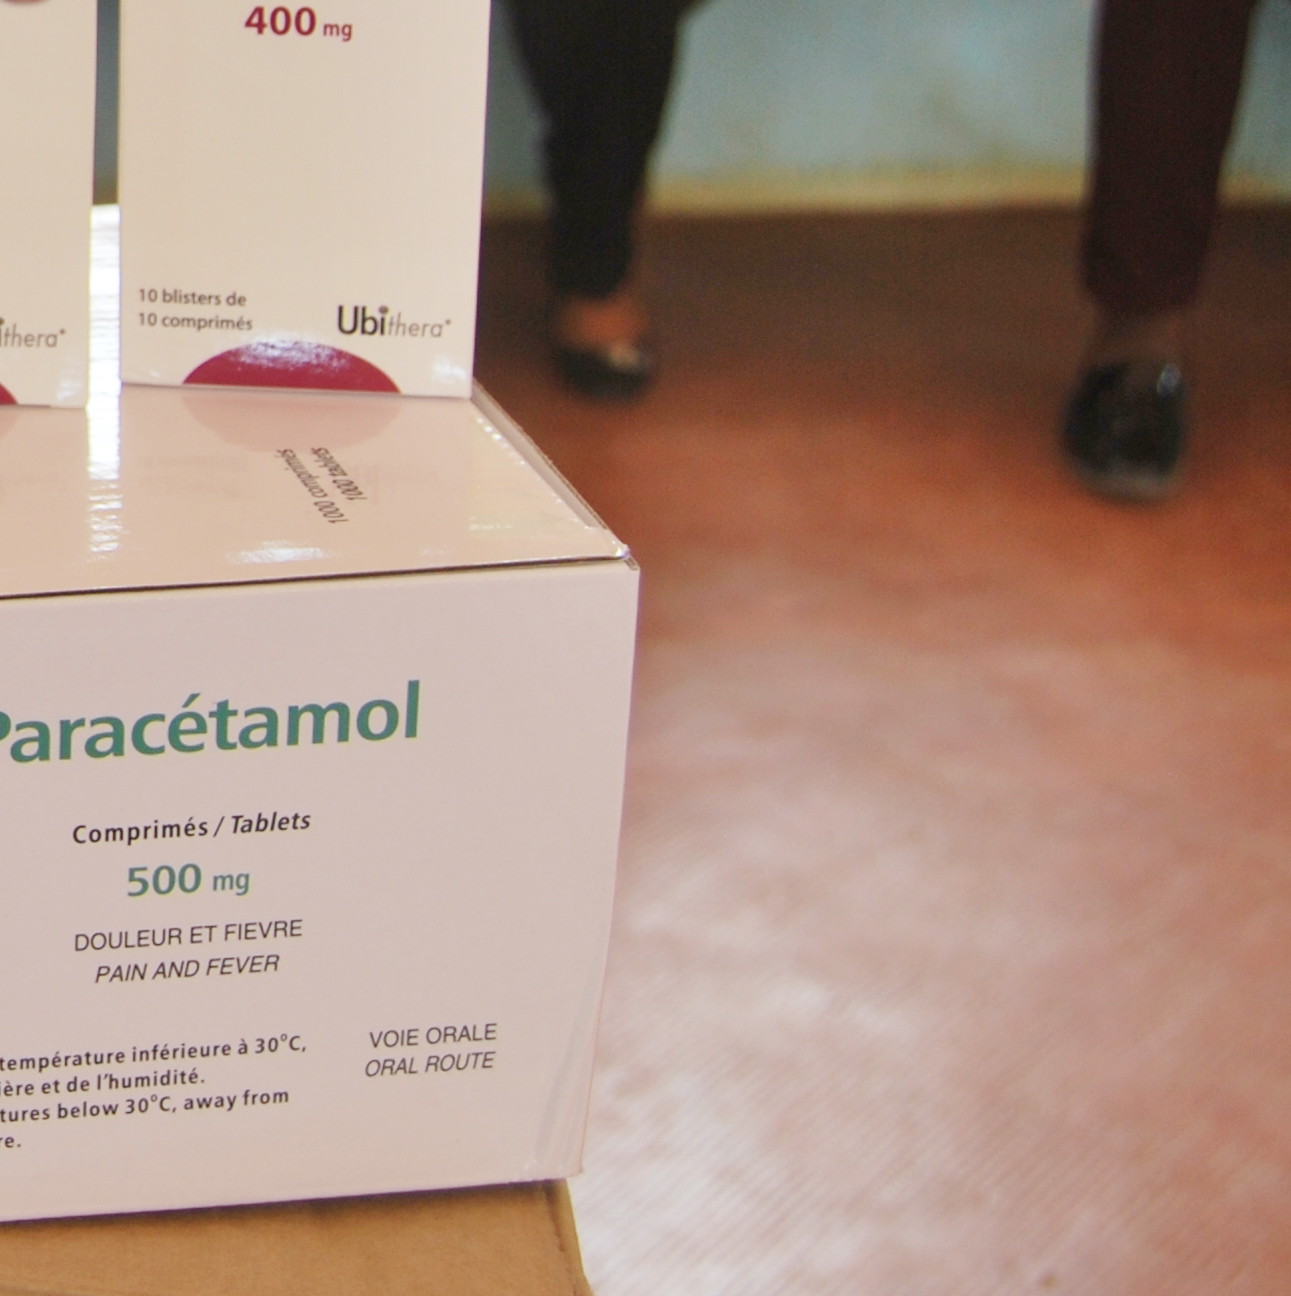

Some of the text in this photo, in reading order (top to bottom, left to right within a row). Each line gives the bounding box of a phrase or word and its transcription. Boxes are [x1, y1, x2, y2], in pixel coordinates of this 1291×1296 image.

[245, 6, 352, 41] 400 mg
[139, 289, 246, 307] 10 blisters de
[138, 312, 253, 331] 10 comprimés
[72, 811, 311, 846] Comprimés Tablets
[127, 863, 250, 897] 500 mg
[74, 919, 303, 952] DOULEUR ET FIEVRE
[95, 954, 280, 984] PAIN AND FEVER
[369, 1023, 497, 1048] VOIE ORALE
[132, 1042, 232, 1063] inférieure
[237, 1038, 248, 1055] à
[365, 1051, 496, 1077] ORAL ROUTE
[41, 1078, 60, 1094] et
[66, 1075, 90, 1092] de
[57, 1100, 119, 1119] below
[183, 1093, 237, 1111] away
[242, 1089, 289, 1106] from
